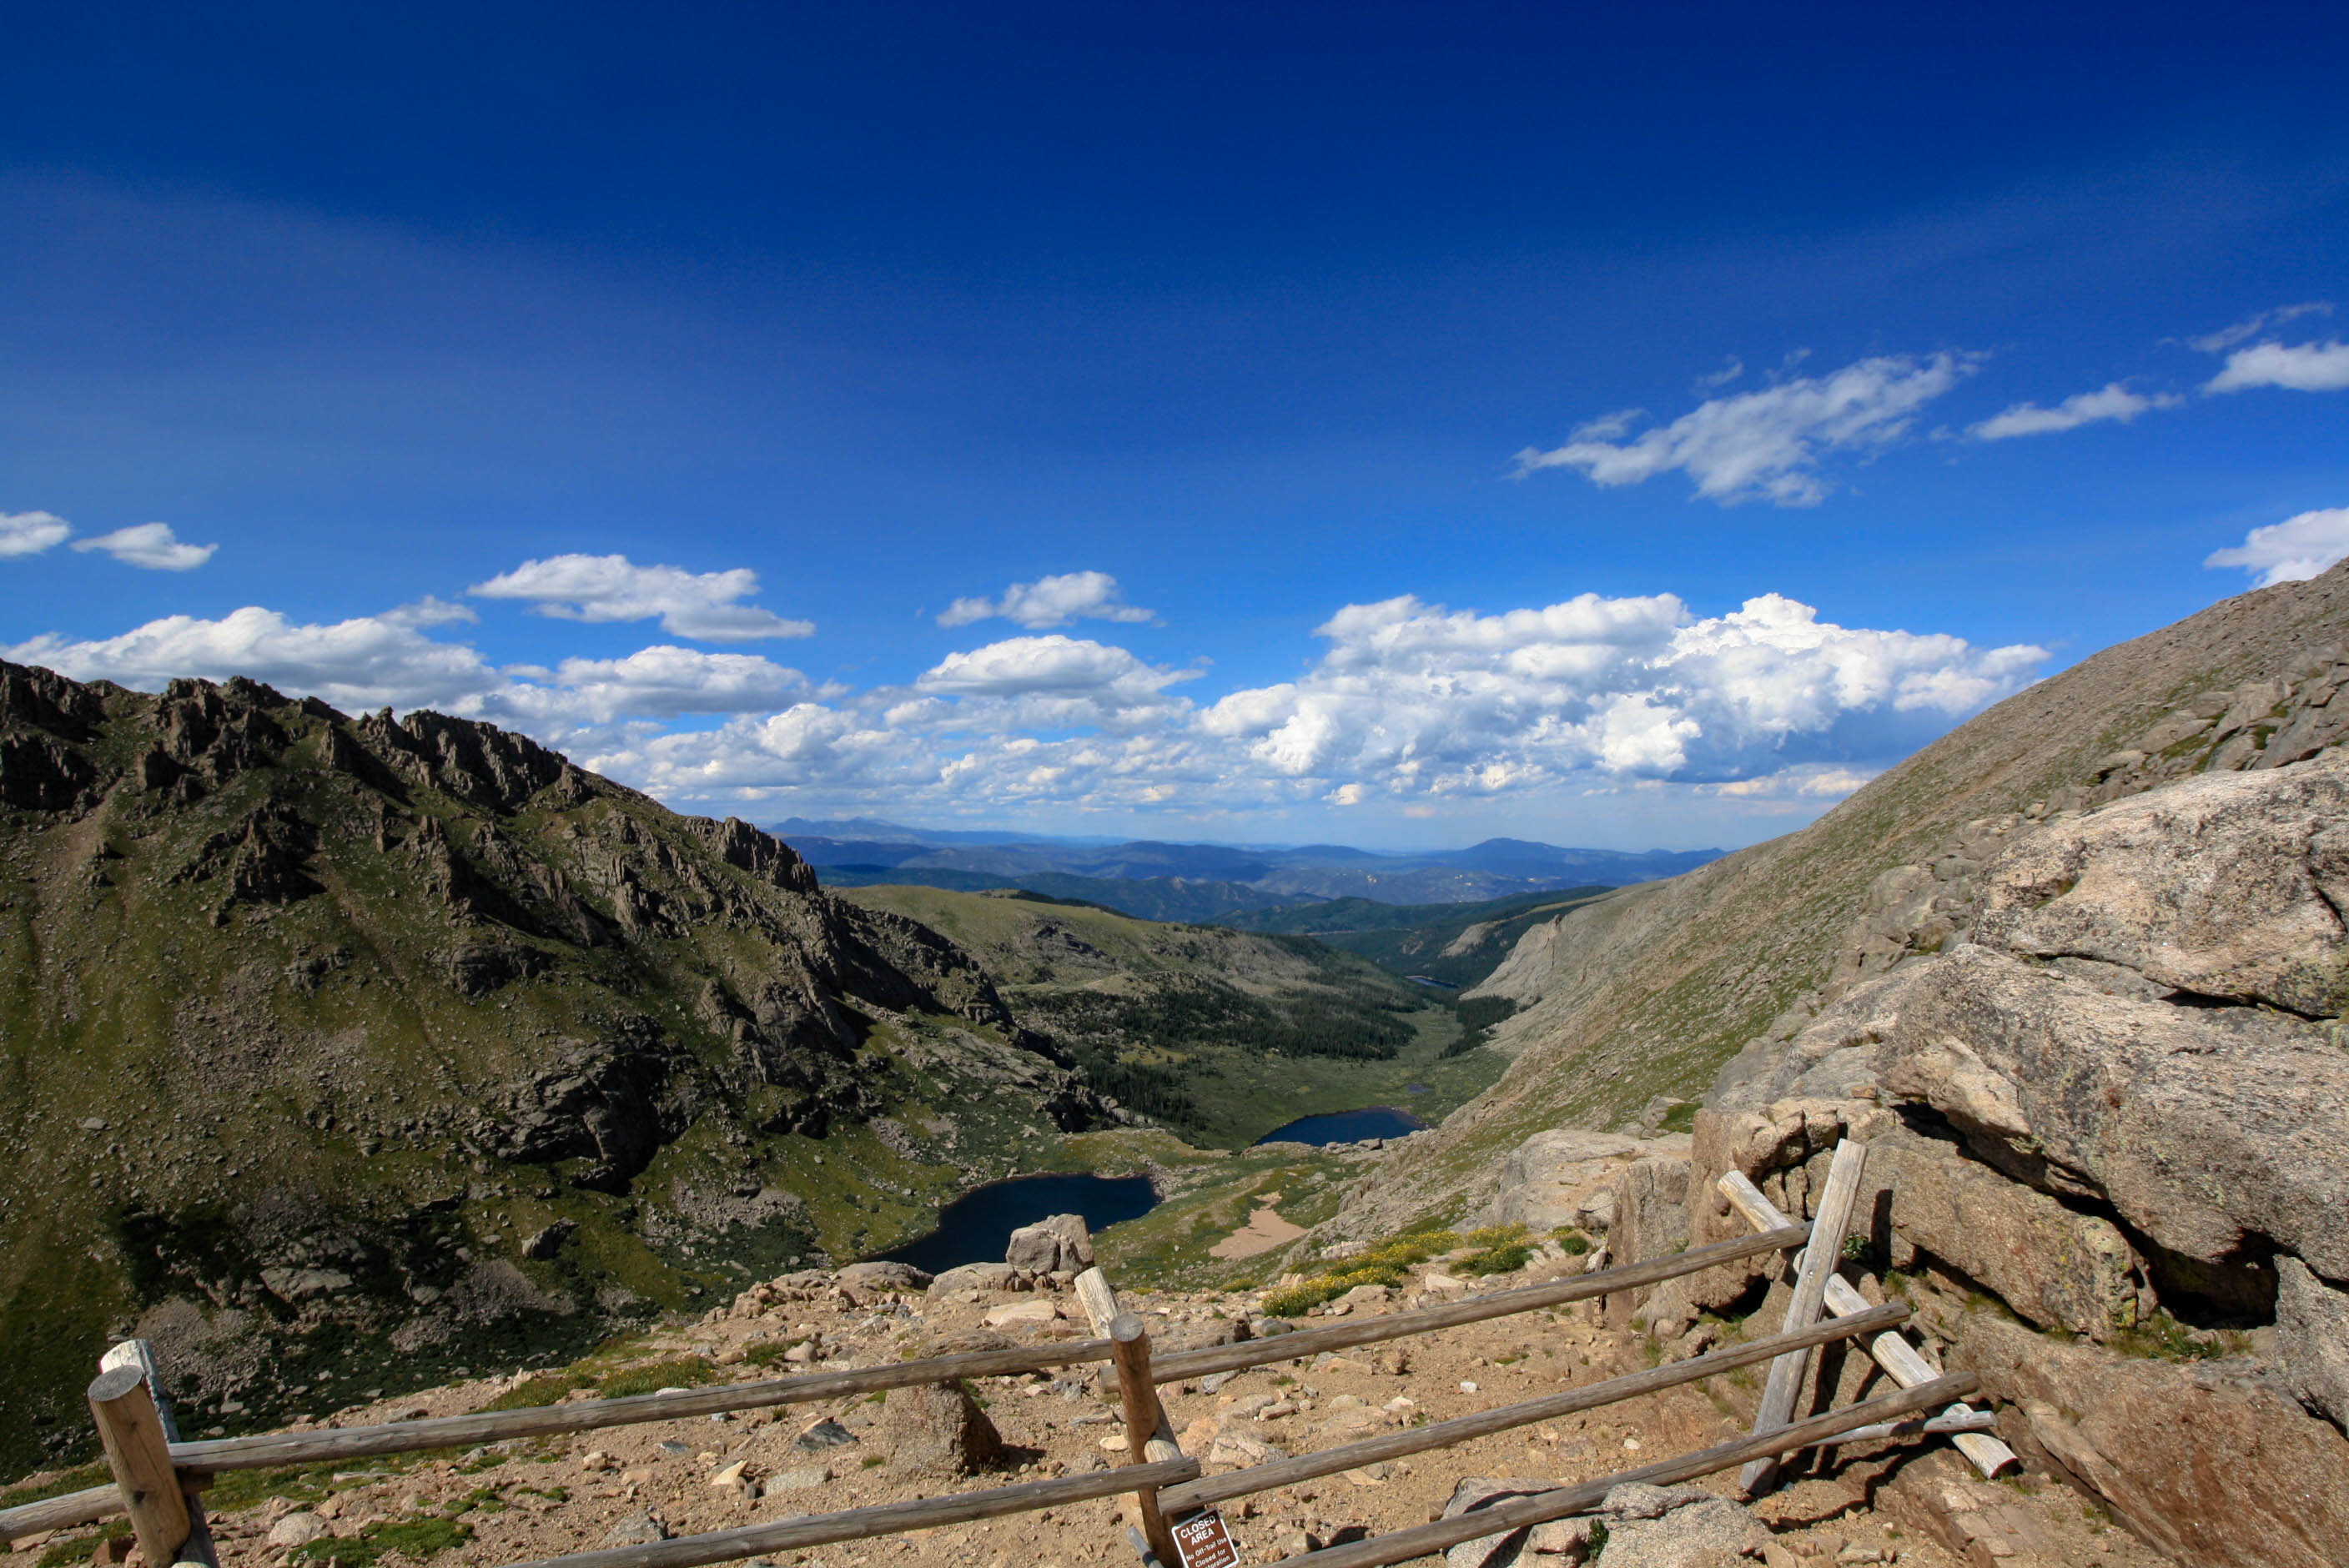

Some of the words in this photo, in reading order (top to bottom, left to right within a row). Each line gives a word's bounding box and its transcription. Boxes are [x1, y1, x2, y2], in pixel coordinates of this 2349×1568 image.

[1180, 1515, 1216, 1538] CLOSED
[1191, 1528, 1215, 1545] AREA
[1195, 1541, 1216, 1556] Off-Trail
[1217, 1537, 1227, 1545] Use
[1195, 1552, 1216, 1567] Closed
[1217, 1548, 1226, 1556] for
